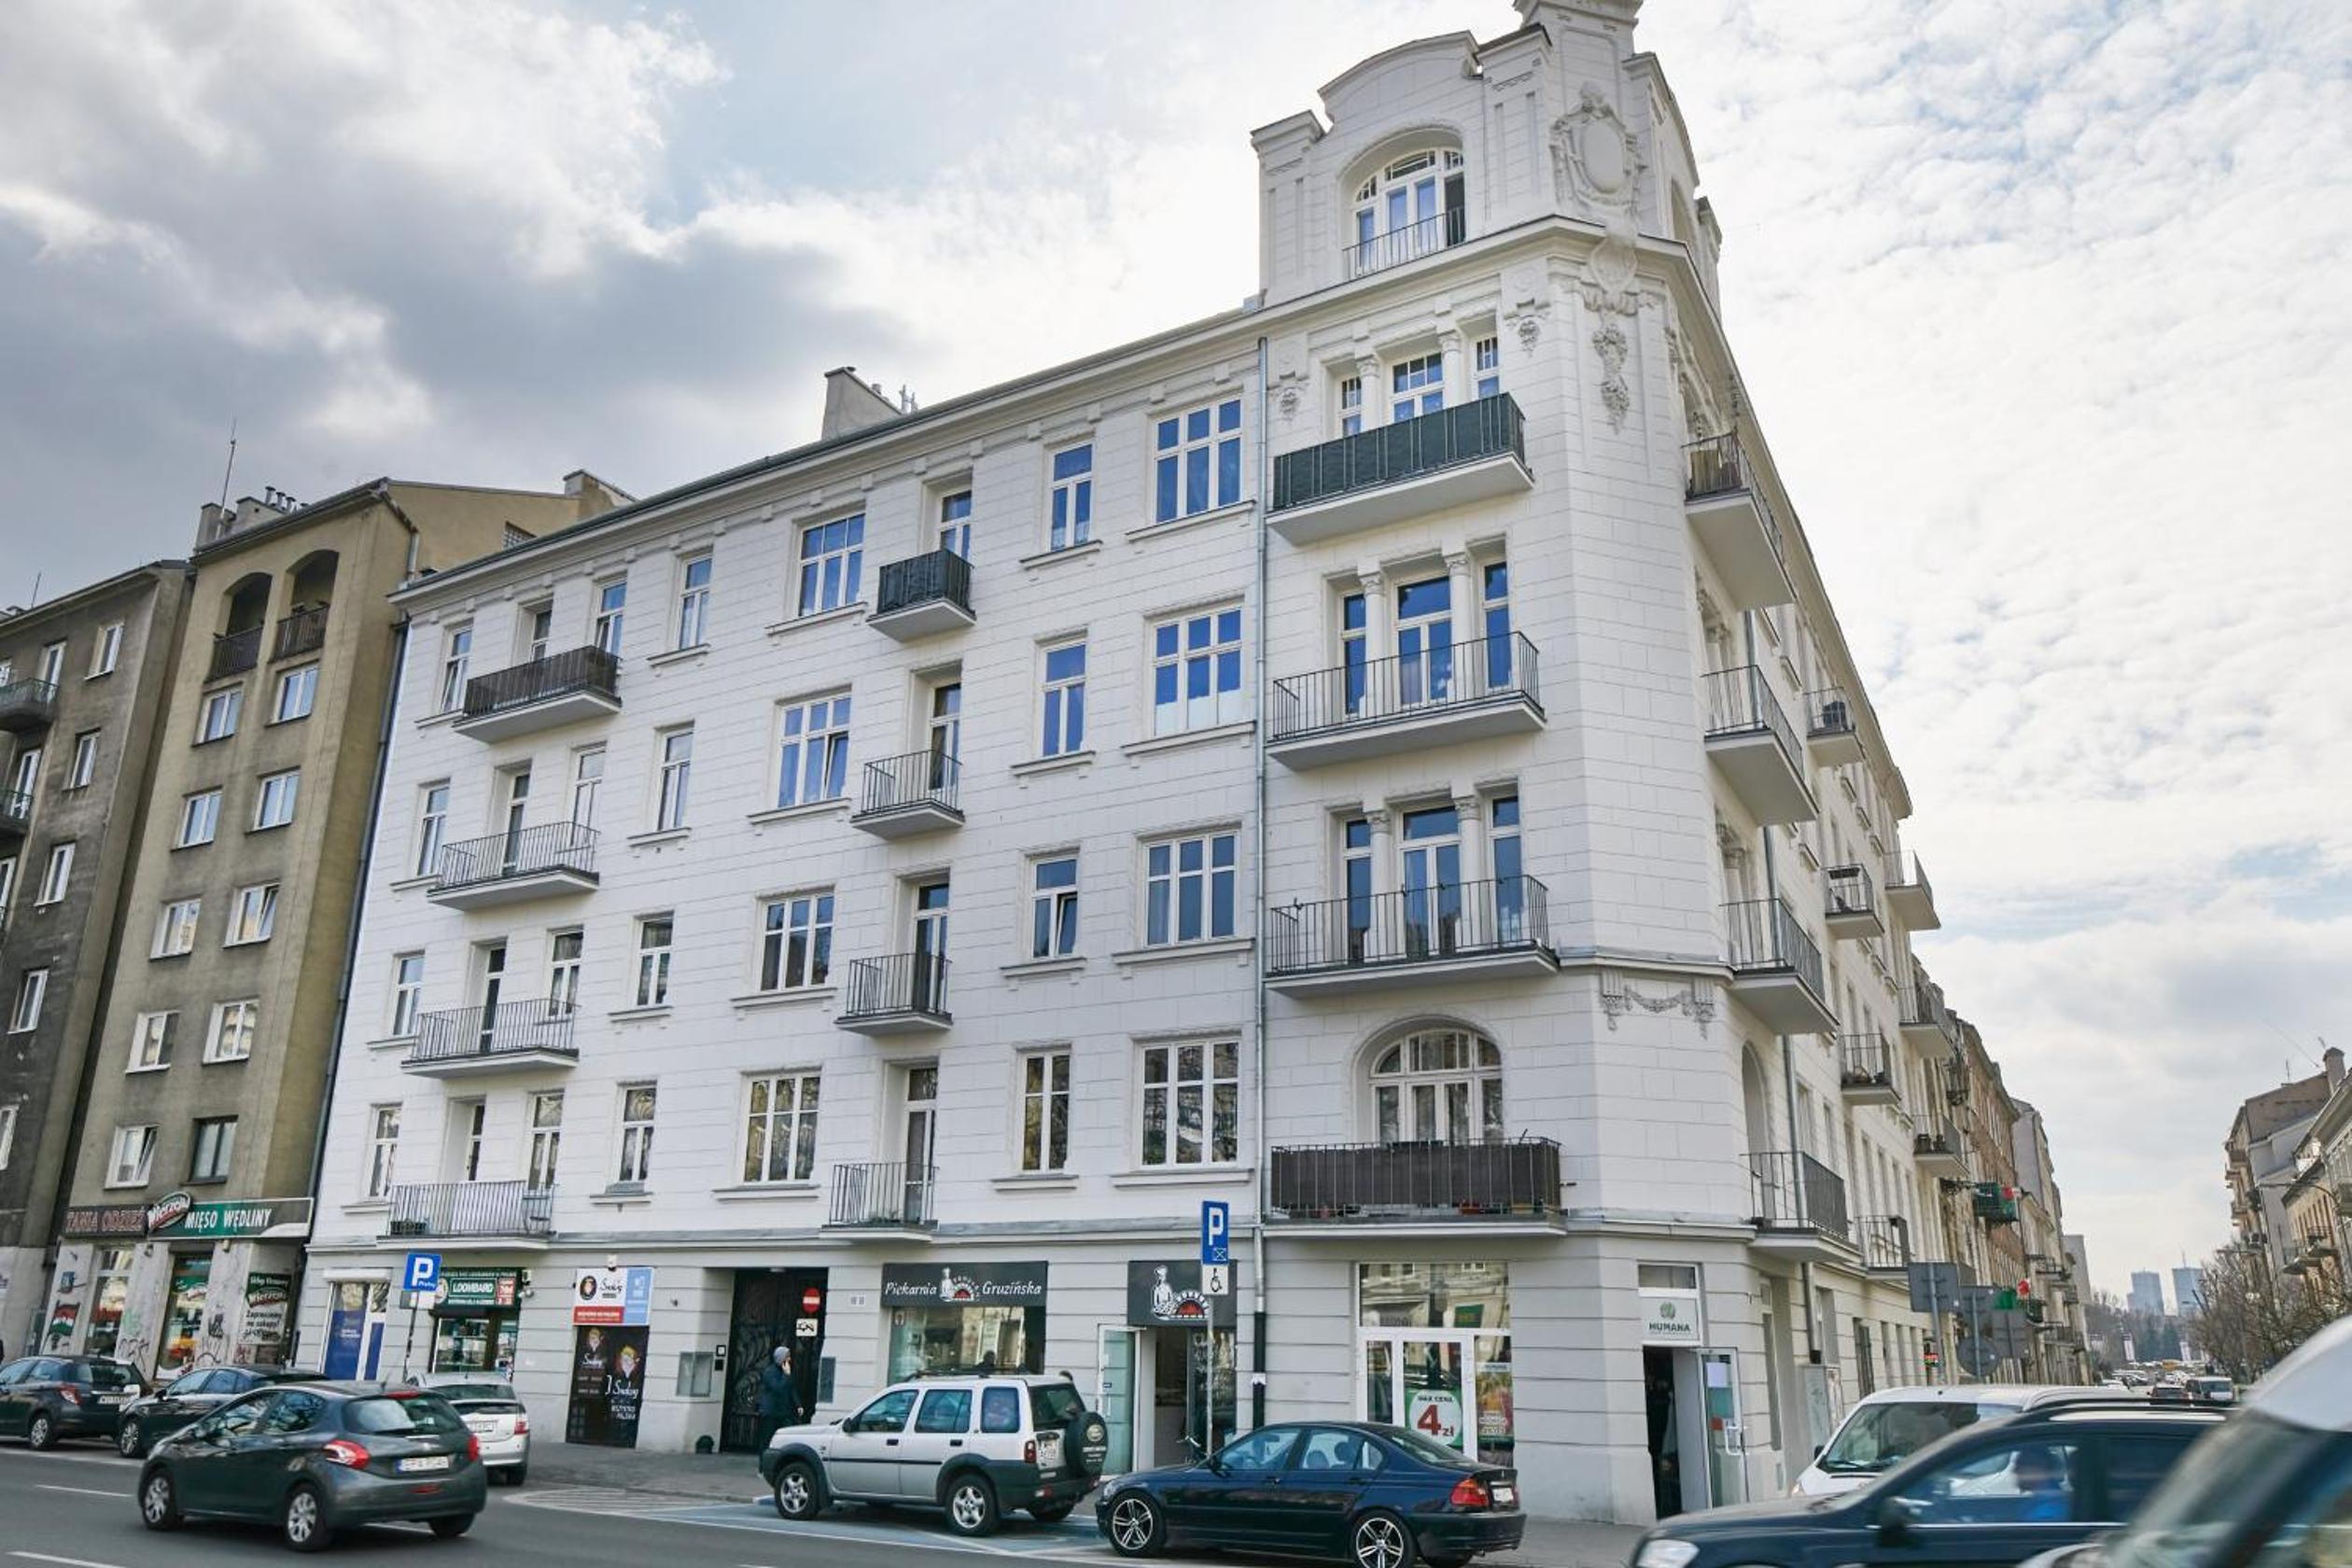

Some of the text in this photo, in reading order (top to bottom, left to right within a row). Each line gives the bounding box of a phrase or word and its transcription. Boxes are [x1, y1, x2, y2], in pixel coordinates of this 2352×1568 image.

[185, 1209, 272, 1233] MIĘSO WĘDLINY
[1209, 1208, 1224, 1245] P
[412, 1257, 434, 1286] P
[886, 1281, 937, 1295] Piekarnia
[982, 1281, 1042, 1295] Gruzińska
[1649, 1323, 1691, 1332] HUMANA
[1417, 1404, 1455, 1436] 4 zł
